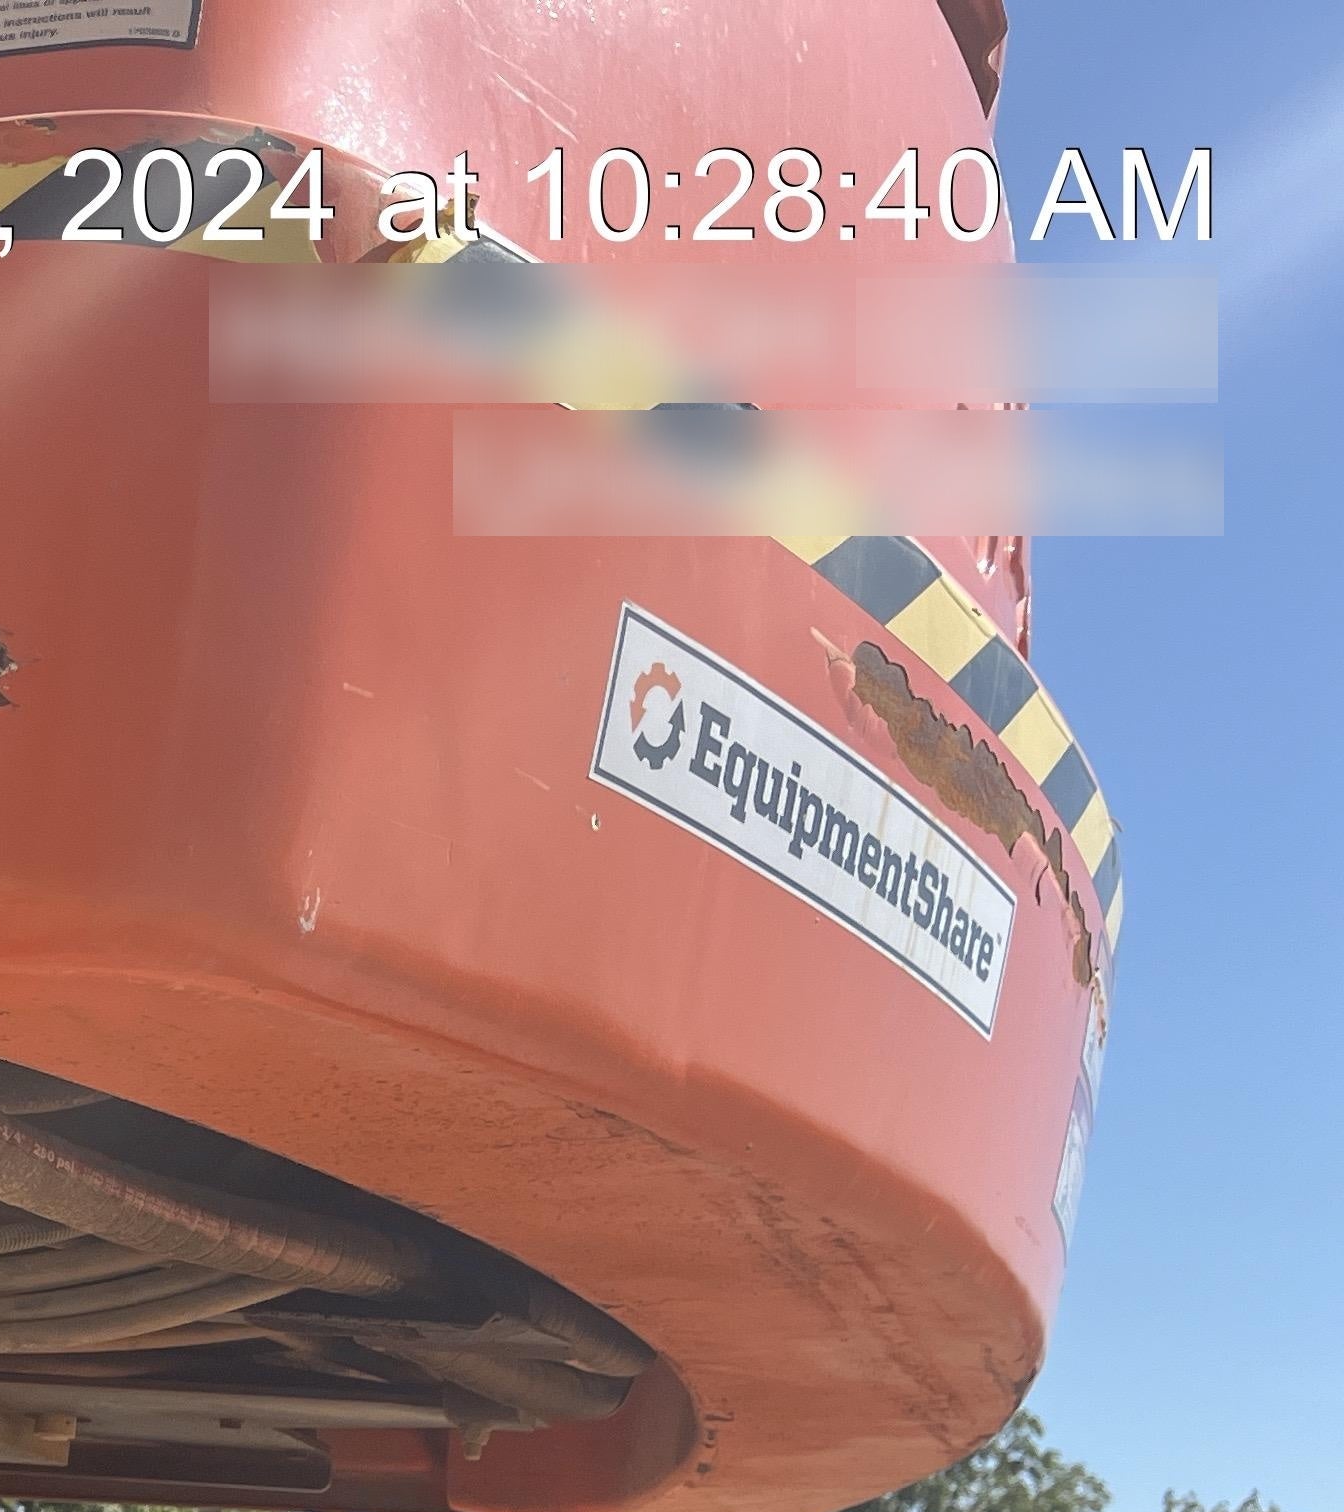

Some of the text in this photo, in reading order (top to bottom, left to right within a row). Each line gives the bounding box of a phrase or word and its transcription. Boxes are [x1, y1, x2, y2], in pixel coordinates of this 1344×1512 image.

[4, 12, 82, 28] instructions
[86, 8, 109, 18] will
[112, 6, 152, 16] result
[690, 701, 994, 982] EquipmentShare
